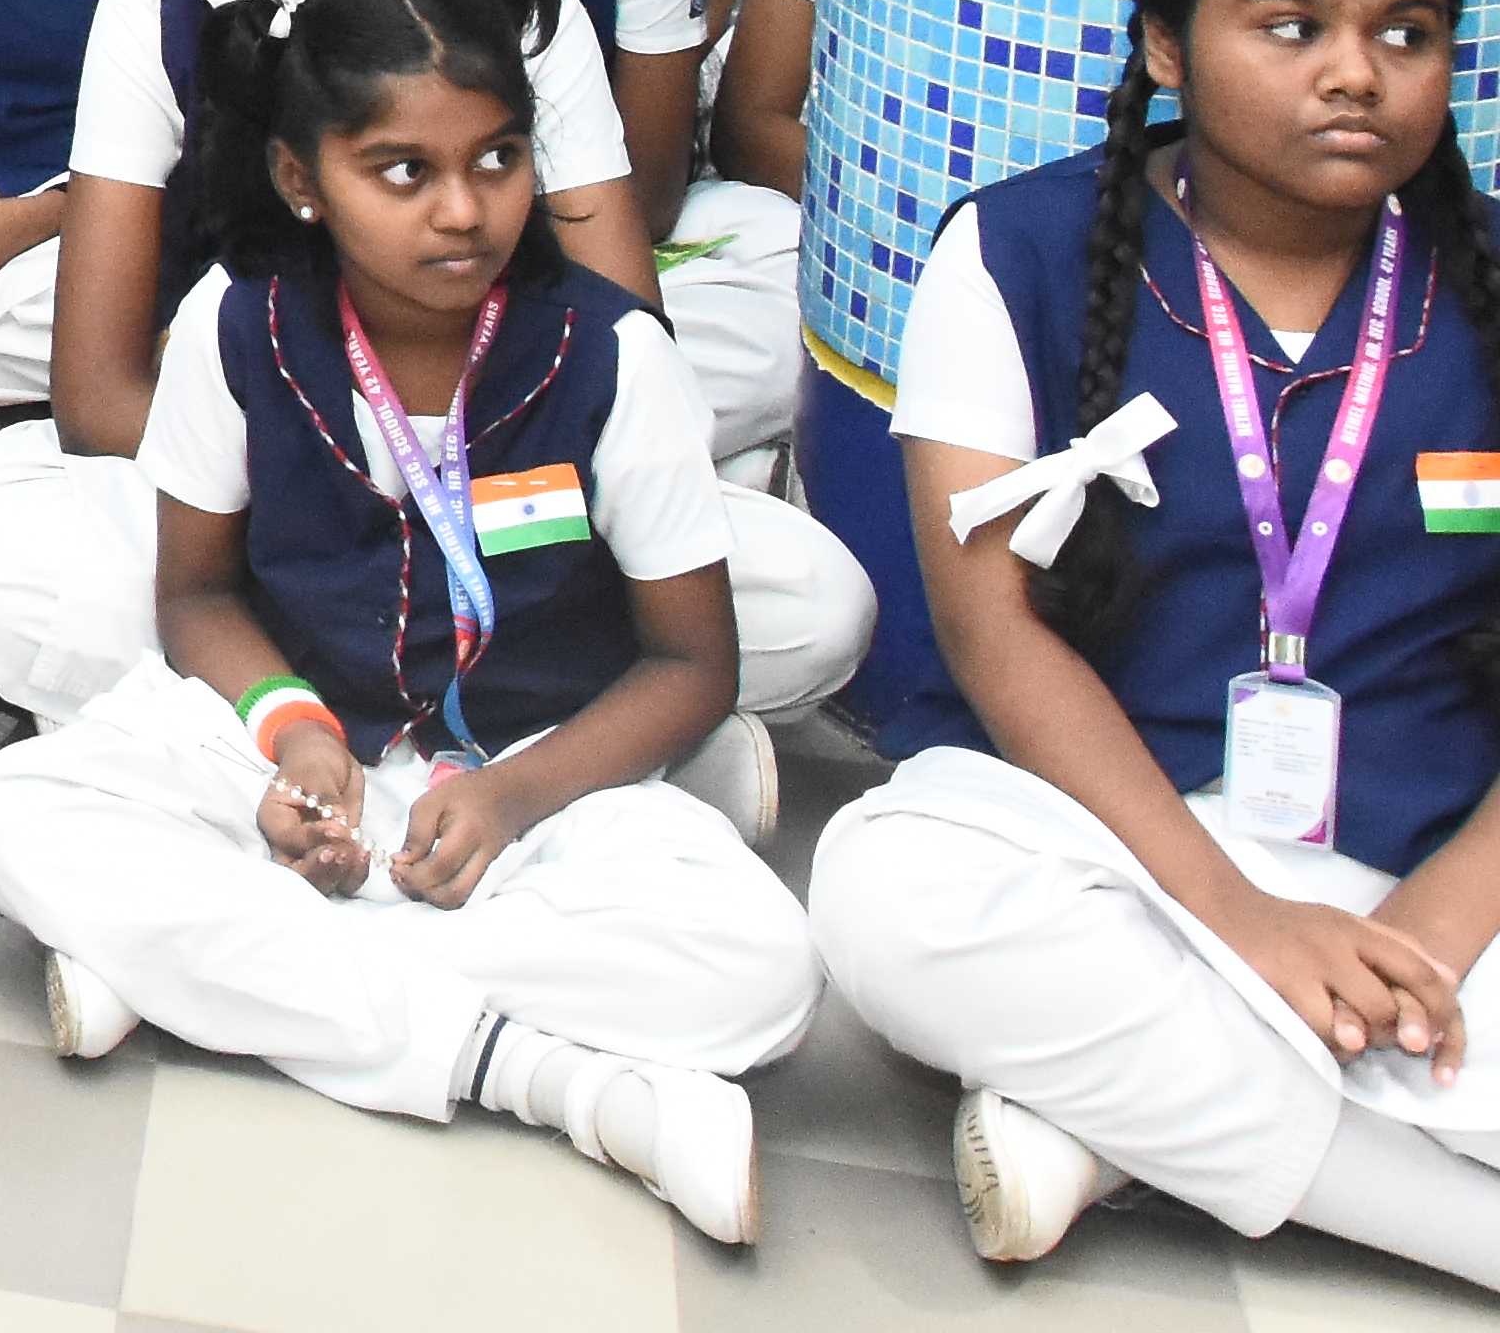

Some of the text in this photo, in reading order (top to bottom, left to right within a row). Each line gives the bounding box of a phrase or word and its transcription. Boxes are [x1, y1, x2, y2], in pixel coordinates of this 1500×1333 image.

[479, 300, 499, 344] YEARS
[364, 376, 382, 395] 42
[1231, 397, 1255, 437] BETHEL
